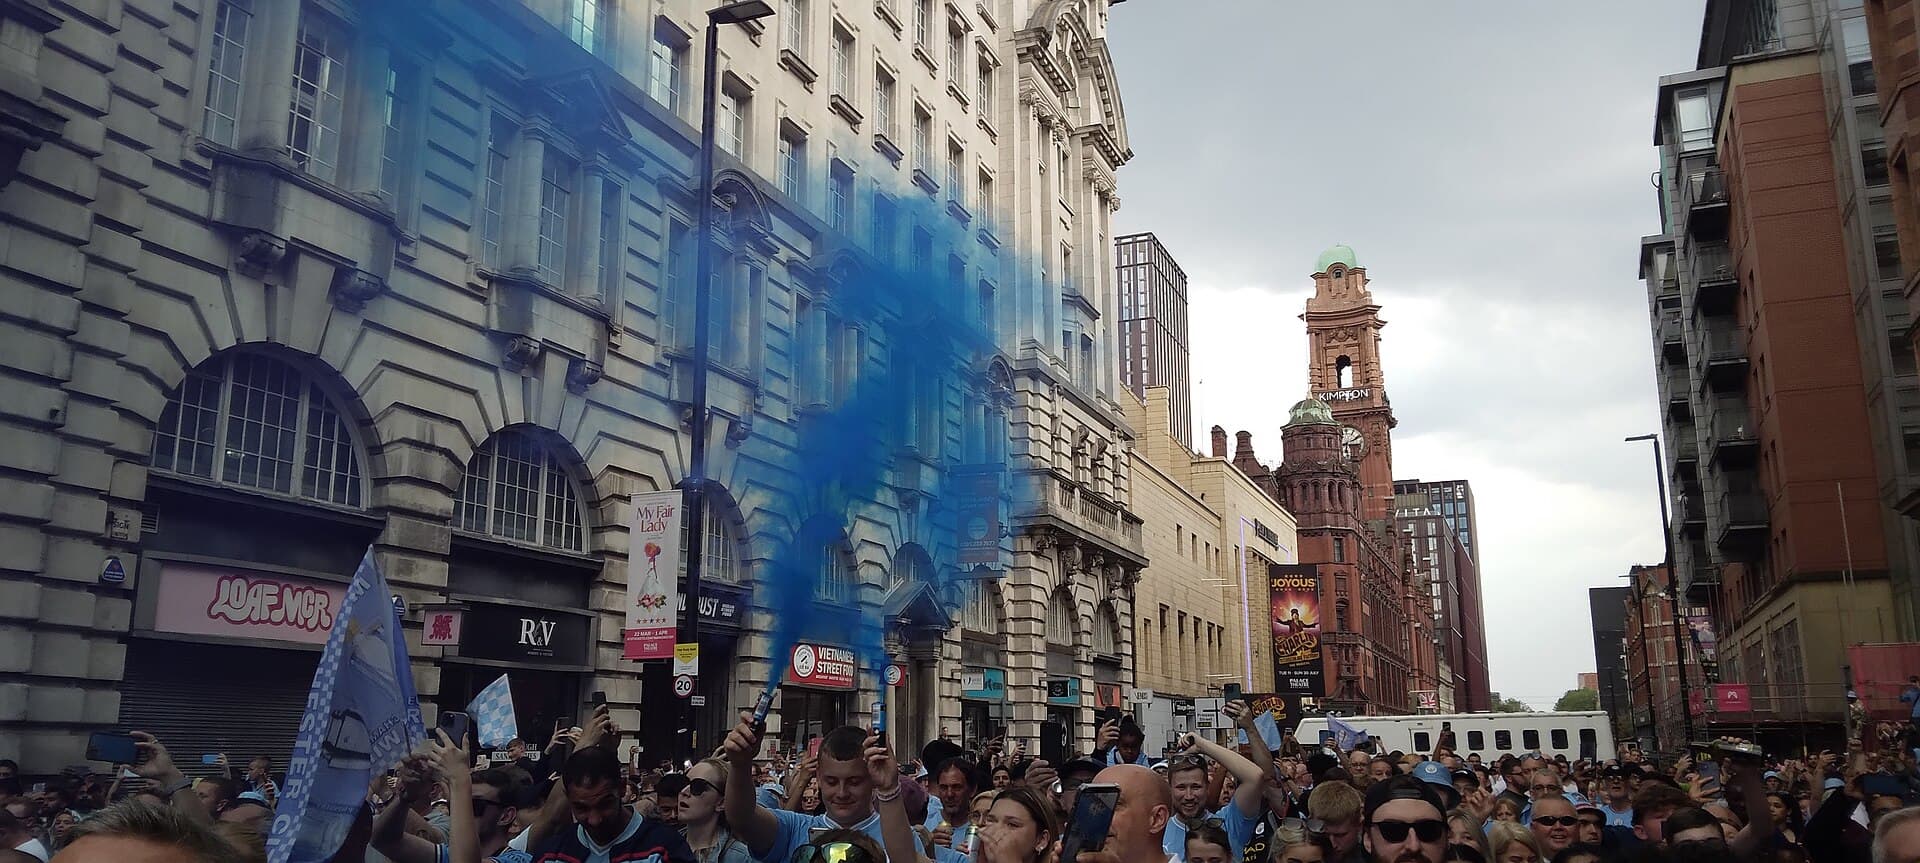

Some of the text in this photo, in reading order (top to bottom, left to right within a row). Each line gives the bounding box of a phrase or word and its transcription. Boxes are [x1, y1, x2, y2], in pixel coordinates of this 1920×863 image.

[1318, 389, 1369, 402] KIMPTON
[637, 504, 675, 521] My Fair
[641, 518, 668, 534] Lady
[208, 576, 332, 631] LOAF MCR
[816, 662, 843, 675] STREET
[676, 680, 691, 691] 20
